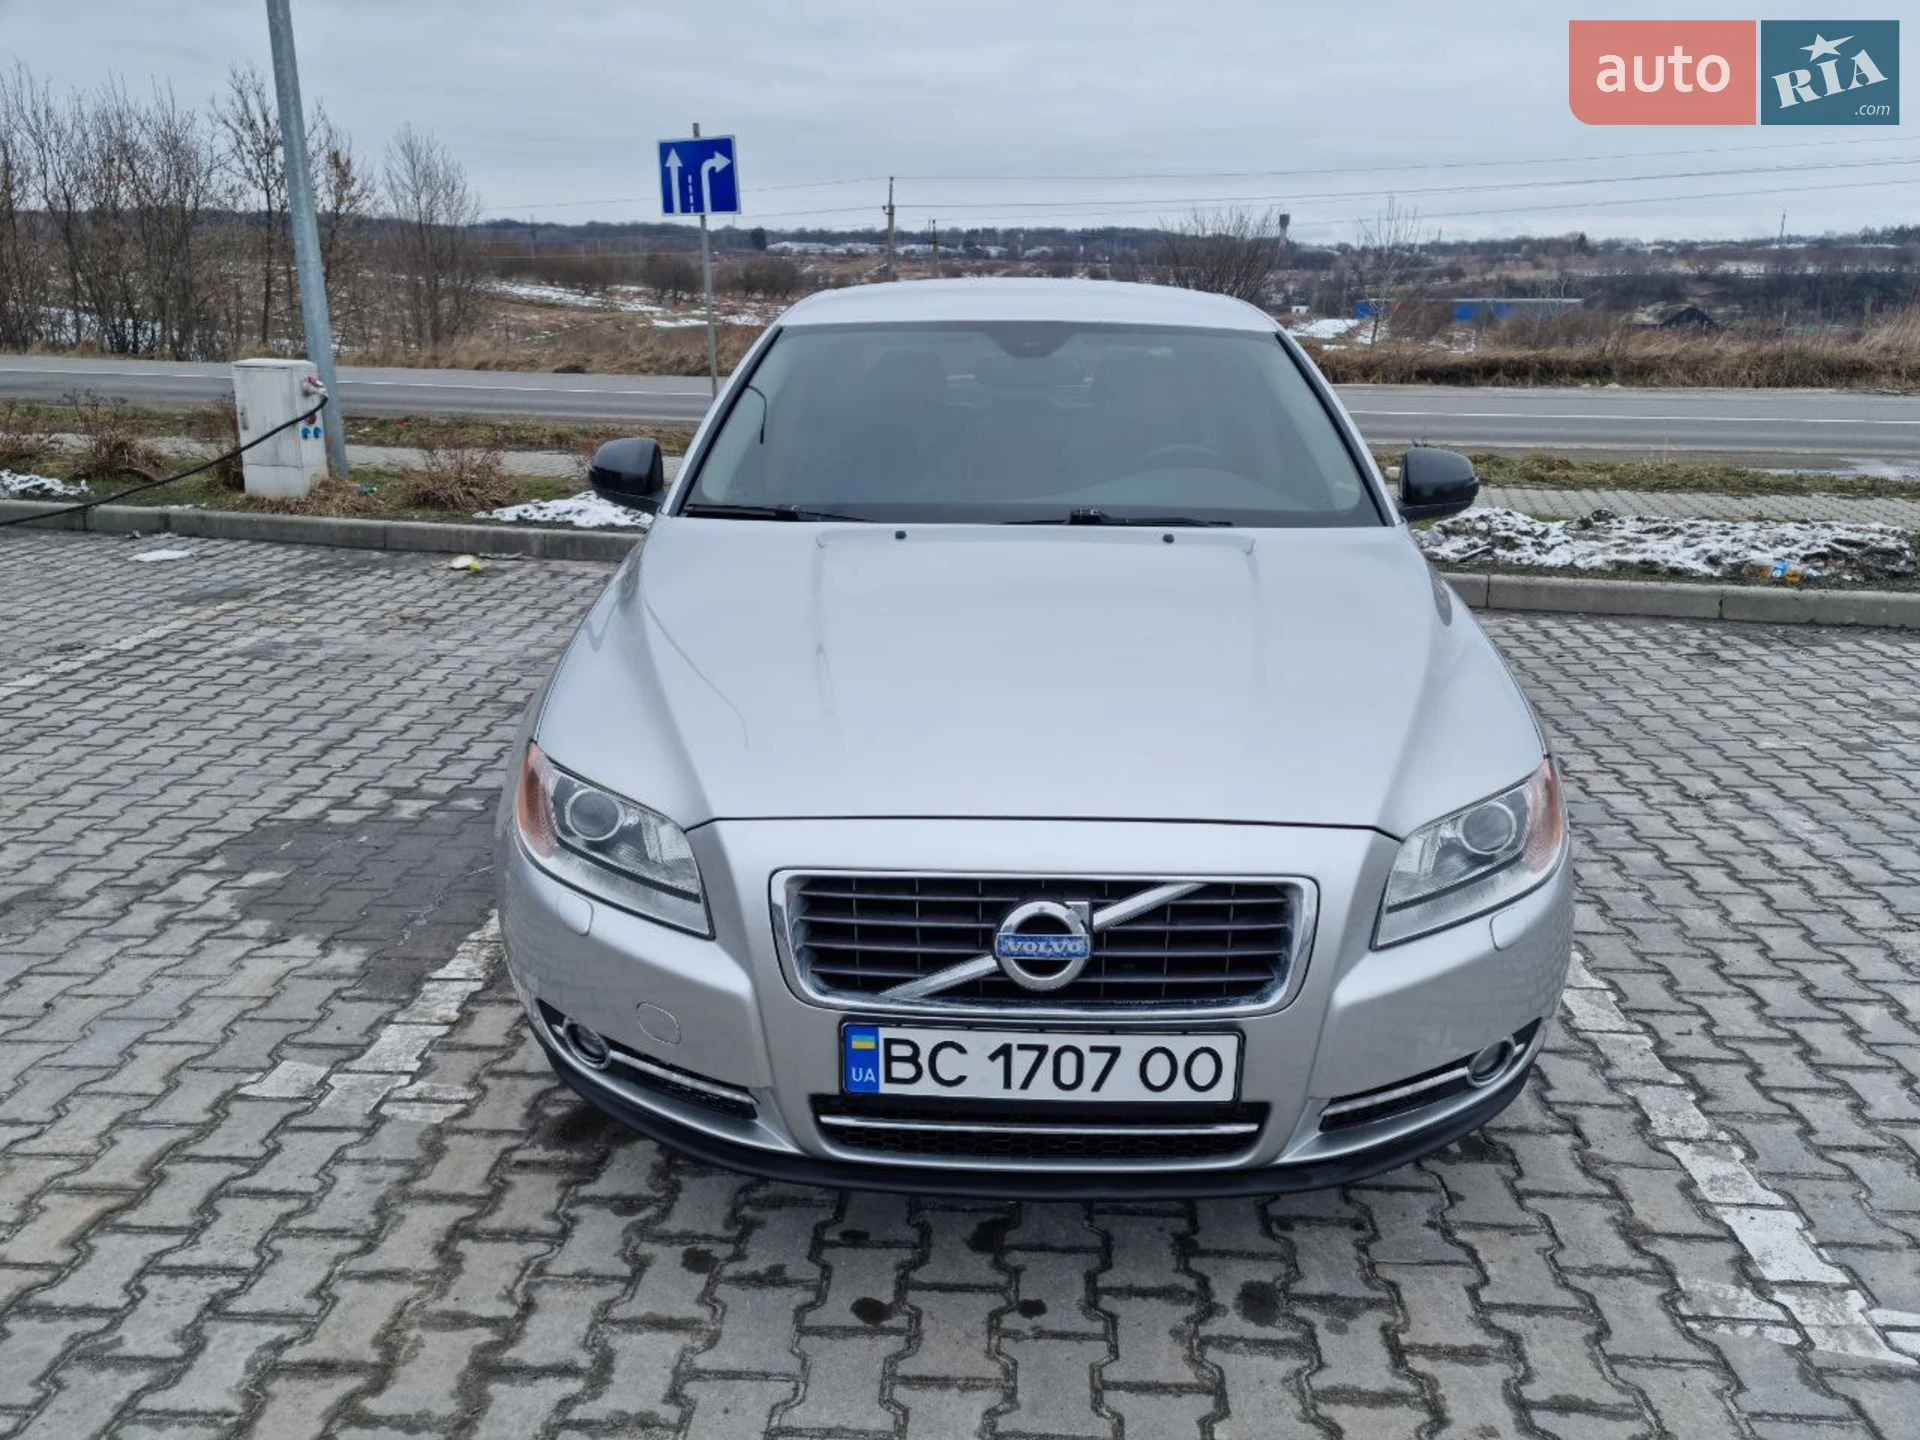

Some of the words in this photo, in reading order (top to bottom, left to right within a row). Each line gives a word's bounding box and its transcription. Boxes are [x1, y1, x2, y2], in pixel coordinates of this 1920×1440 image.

[1005, 940, 1081, 954] VOLVO
[883, 1037, 968, 1087] BC
[987, 1042, 1122, 1092] 1707
[1139, 1046, 1224, 1093] OO
[851, 1067, 877, 1083] UA
